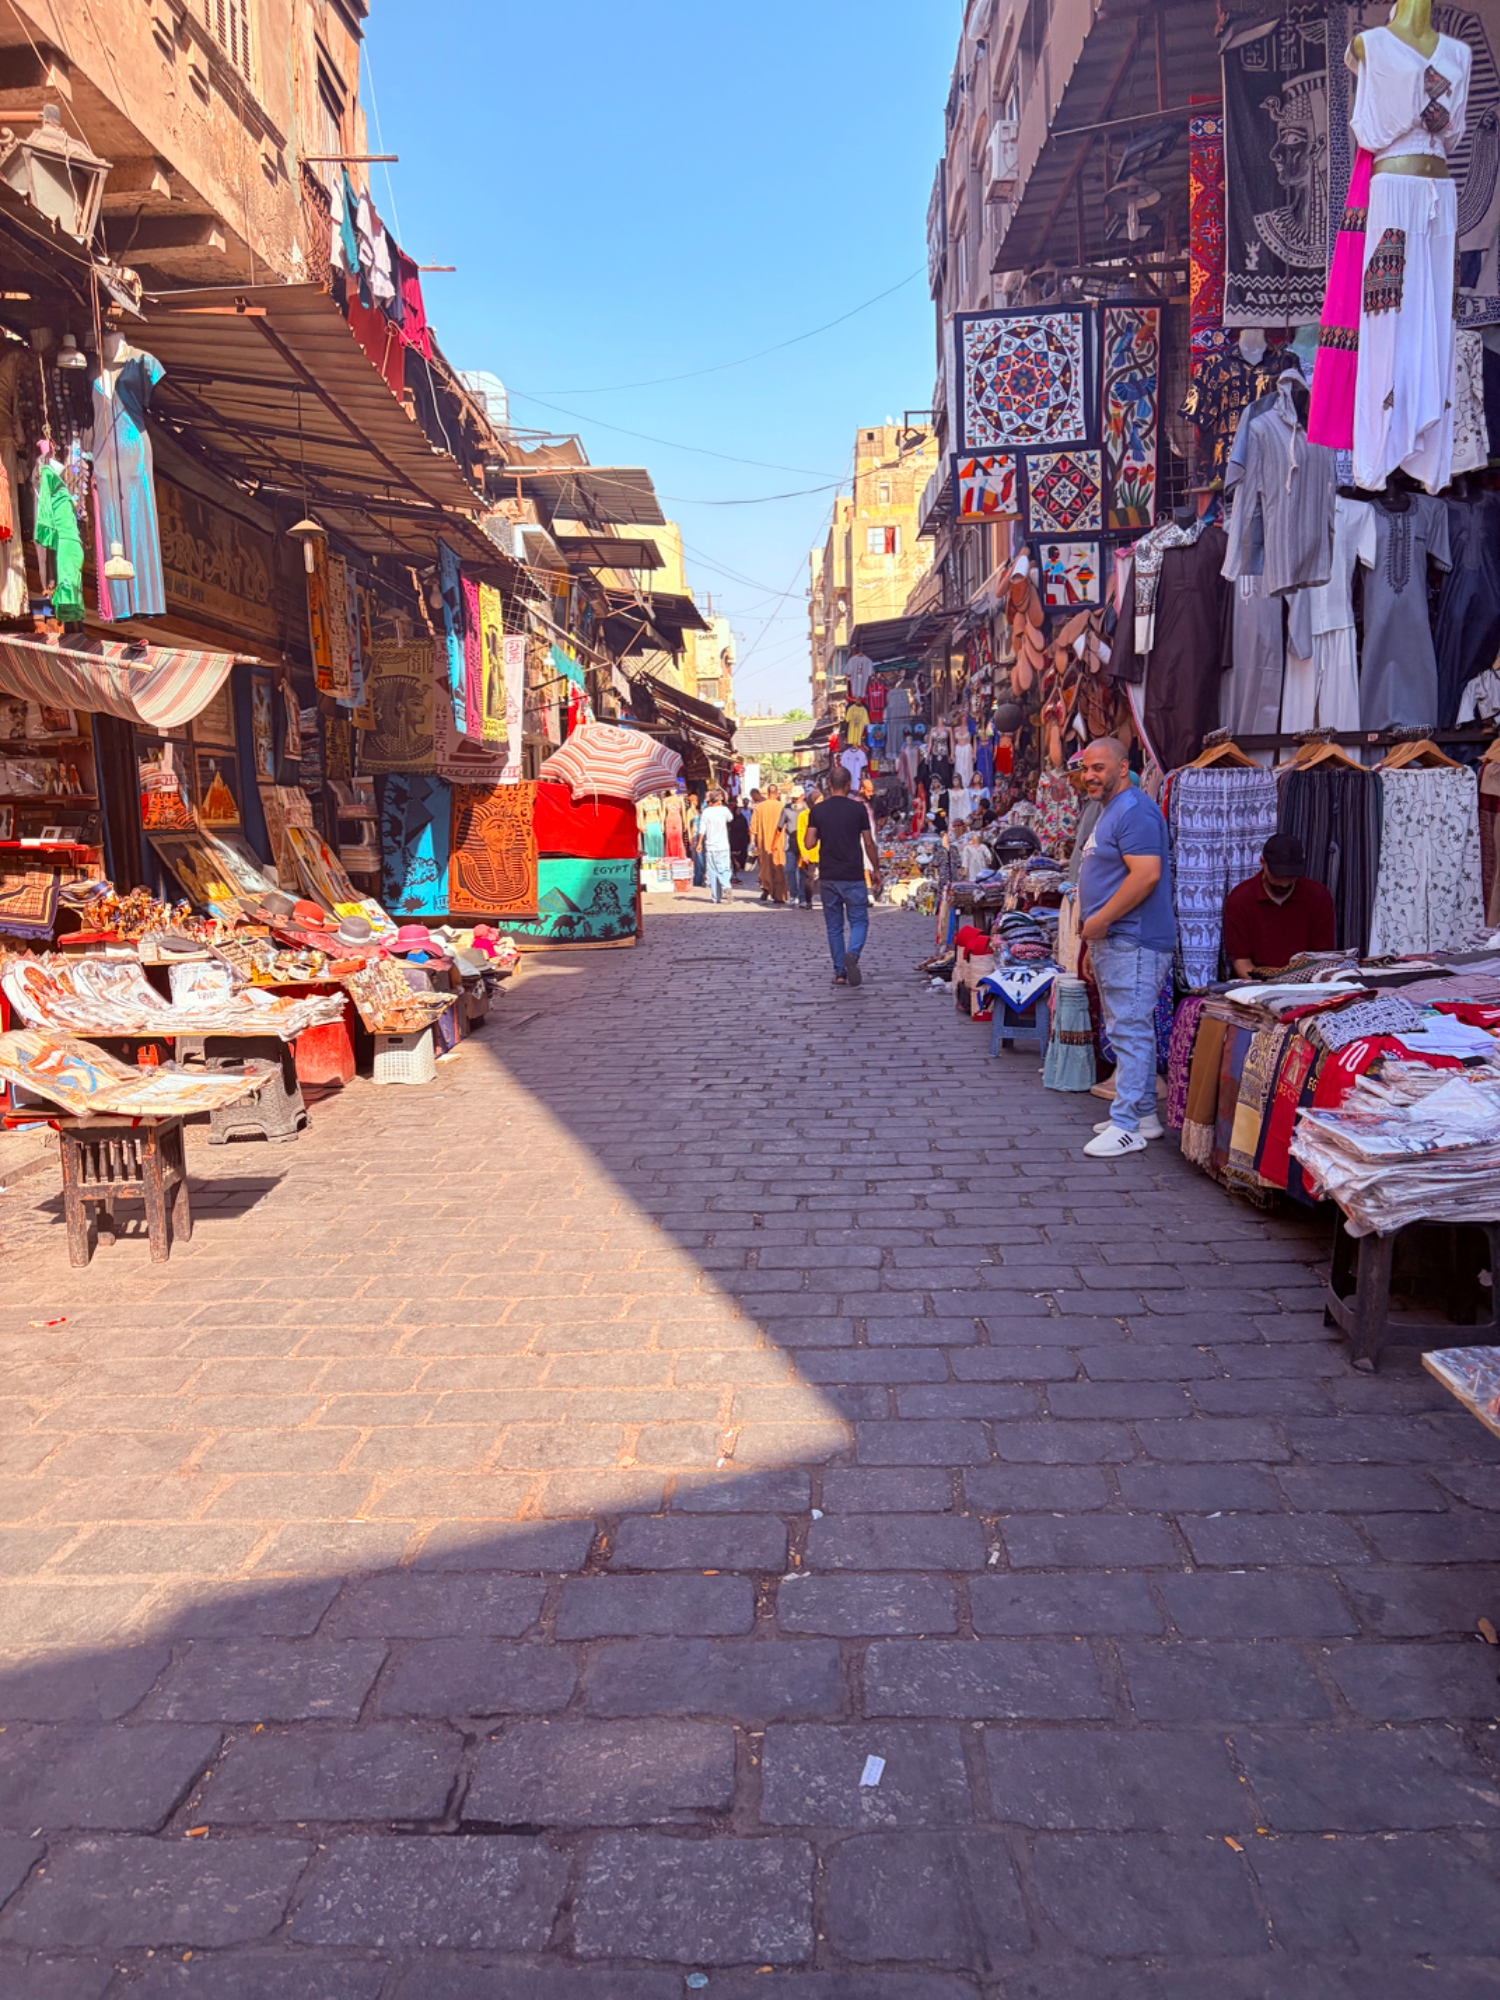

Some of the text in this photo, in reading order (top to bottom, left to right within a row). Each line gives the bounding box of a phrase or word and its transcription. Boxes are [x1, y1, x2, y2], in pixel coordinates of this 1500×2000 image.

[593, 865, 629, 875] EGYPT
[474, 902, 514, 911] EGYPT
[1338, 1040, 1369, 1072] 10
[1307, 1077, 1317, 1092] EG
